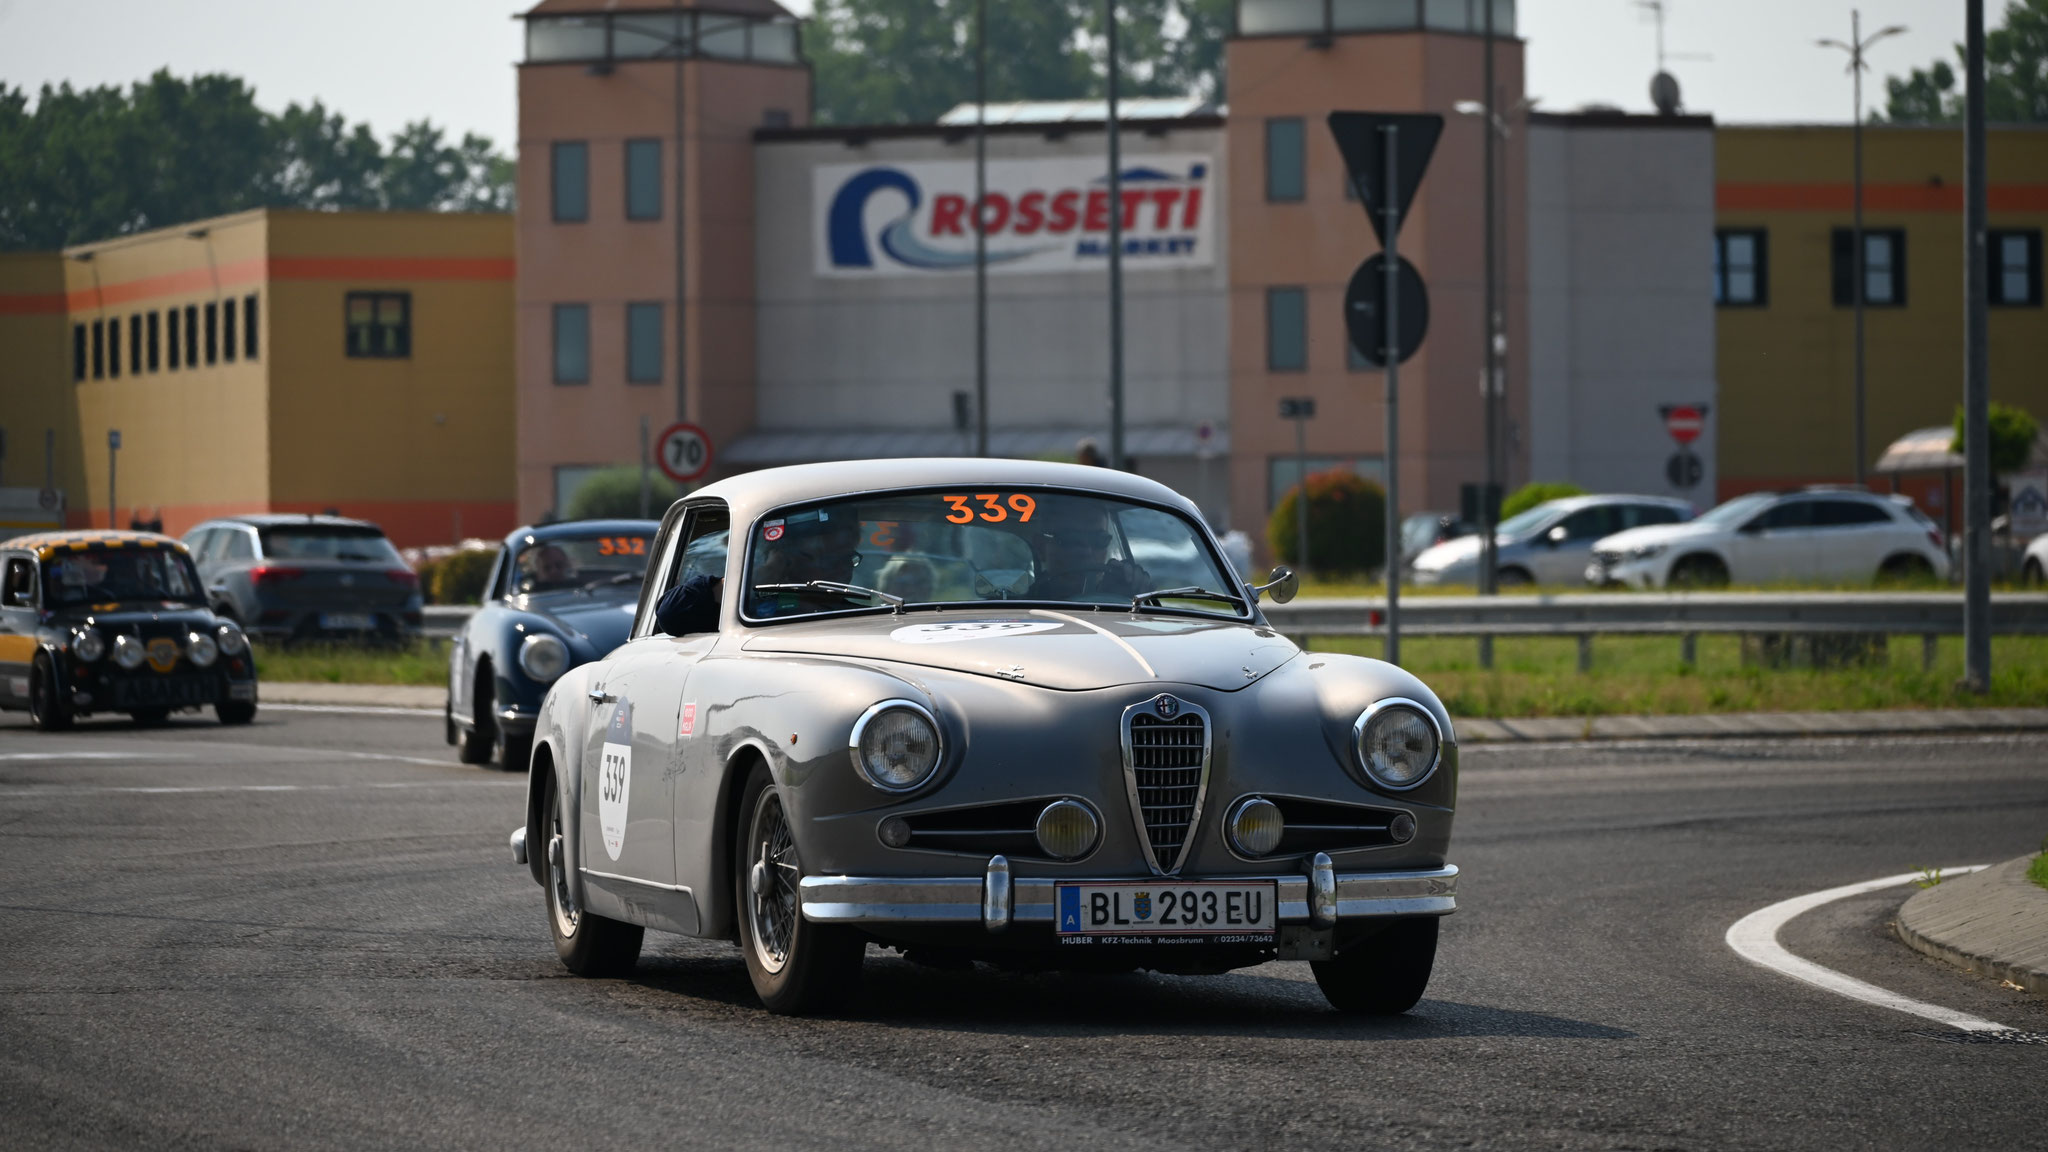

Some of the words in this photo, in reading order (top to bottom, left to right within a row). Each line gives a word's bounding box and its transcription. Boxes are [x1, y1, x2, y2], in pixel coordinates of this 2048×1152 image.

[930, 165, 1207, 238] ROSSETTI
[672, 439, 702, 466] 70
[943, 494, 1036, 524] 339
[598, 537, 646, 556] 332
[920, 623, 1033, 632] 339
[604, 754, 626, 804] 339
[1066, 915, 1076, 926] A
[1090, 892, 1130, 926] BL
[1062, 936, 1093, 945] HUBER
[1102, 936, 1152, 945] KFZ-Technik
[1157, 937, 1204, 945] Moosbrunn
[1220, 935, 1273, 944] 02234/73642
